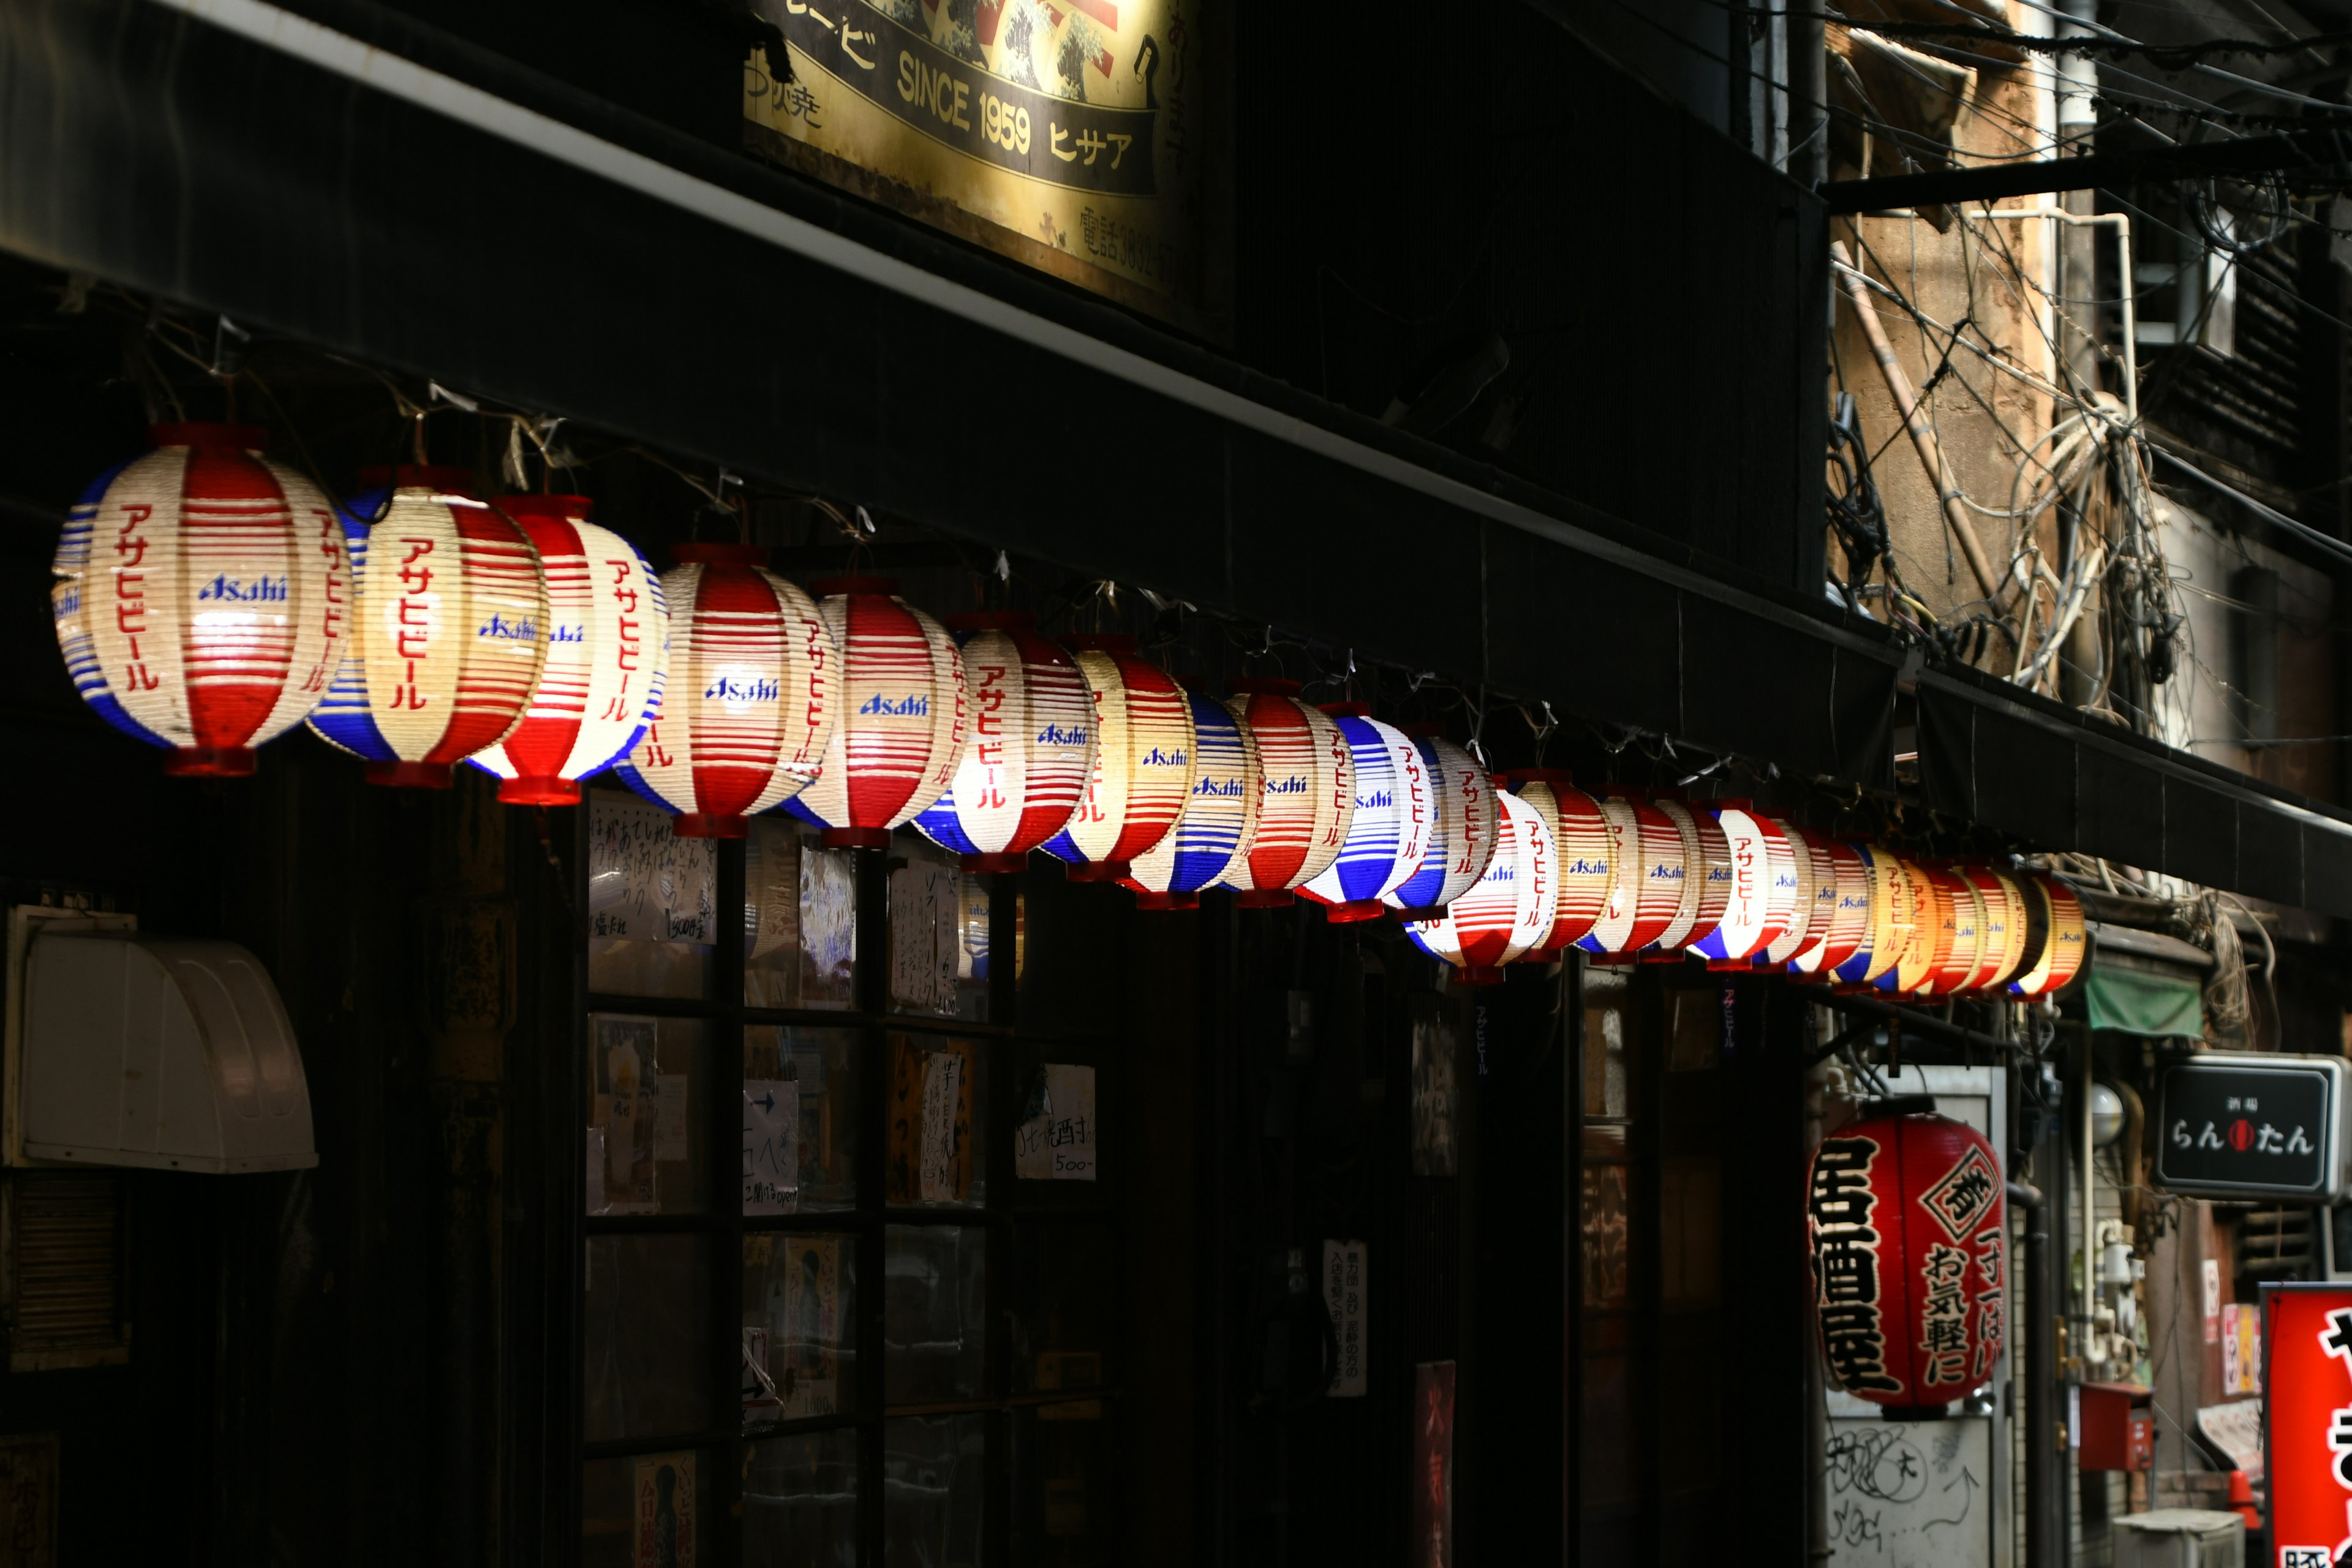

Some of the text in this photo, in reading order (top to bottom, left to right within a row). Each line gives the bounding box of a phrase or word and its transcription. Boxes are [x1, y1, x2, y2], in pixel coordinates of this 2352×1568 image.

[897, 49, 971, 133] SINCE
[979, 90, 1033, 156] 1959
[114, 503, 159, 693] アサヒビール
[198, 572, 288, 603] Asahi
[299, 508, 344, 693] アサヒビール
[389, 537, 434, 710] アサヒビール
[549, 624, 584, 643] ahi
[600, 559, 641, 722] アサヒビール
[705, 677, 779, 703] Asahi
[859, 692, 930, 717] Asahi
[932, 645, 967, 785] アサヒビール
[976, 665, 1006, 810] アサヒビール
[1037, 723, 1087, 747] Asahi
[1143, 746, 1188, 767] Asahi
[1193, 775, 1245, 798] Asahi
[1265, 775, 1307, 794] sahi
[1322, 728, 1348, 847] アサヒビール
[1354, 789, 1392, 810] sahi
[1398, 746, 1425, 859] アサヒビール
[1453, 770, 1481, 875] アサヒビール
[1480, 865, 1513, 883] ahi
[1523, 821, 1547, 927] アサヒビール
[1569, 858, 1608, 875] Asahi
[1650, 863, 1685, 880] Asahi
[1708, 866, 1733, 882] Asah
[1734, 837, 1755, 927] アサヒビール
[1776, 873, 1798, 888] Asah
[1883, 867, 1903, 952] アサヒビール
[1476, 1005, 1488, 1076] アサヒビール
[1724, 989, 1735, 1048] アサヒビール
[1347, 1251, 1359, 1286] 暴力団
[1809, 1136, 1904, 1392] 居酒屋
[1920, 1244, 1970, 1387] お気軽に
